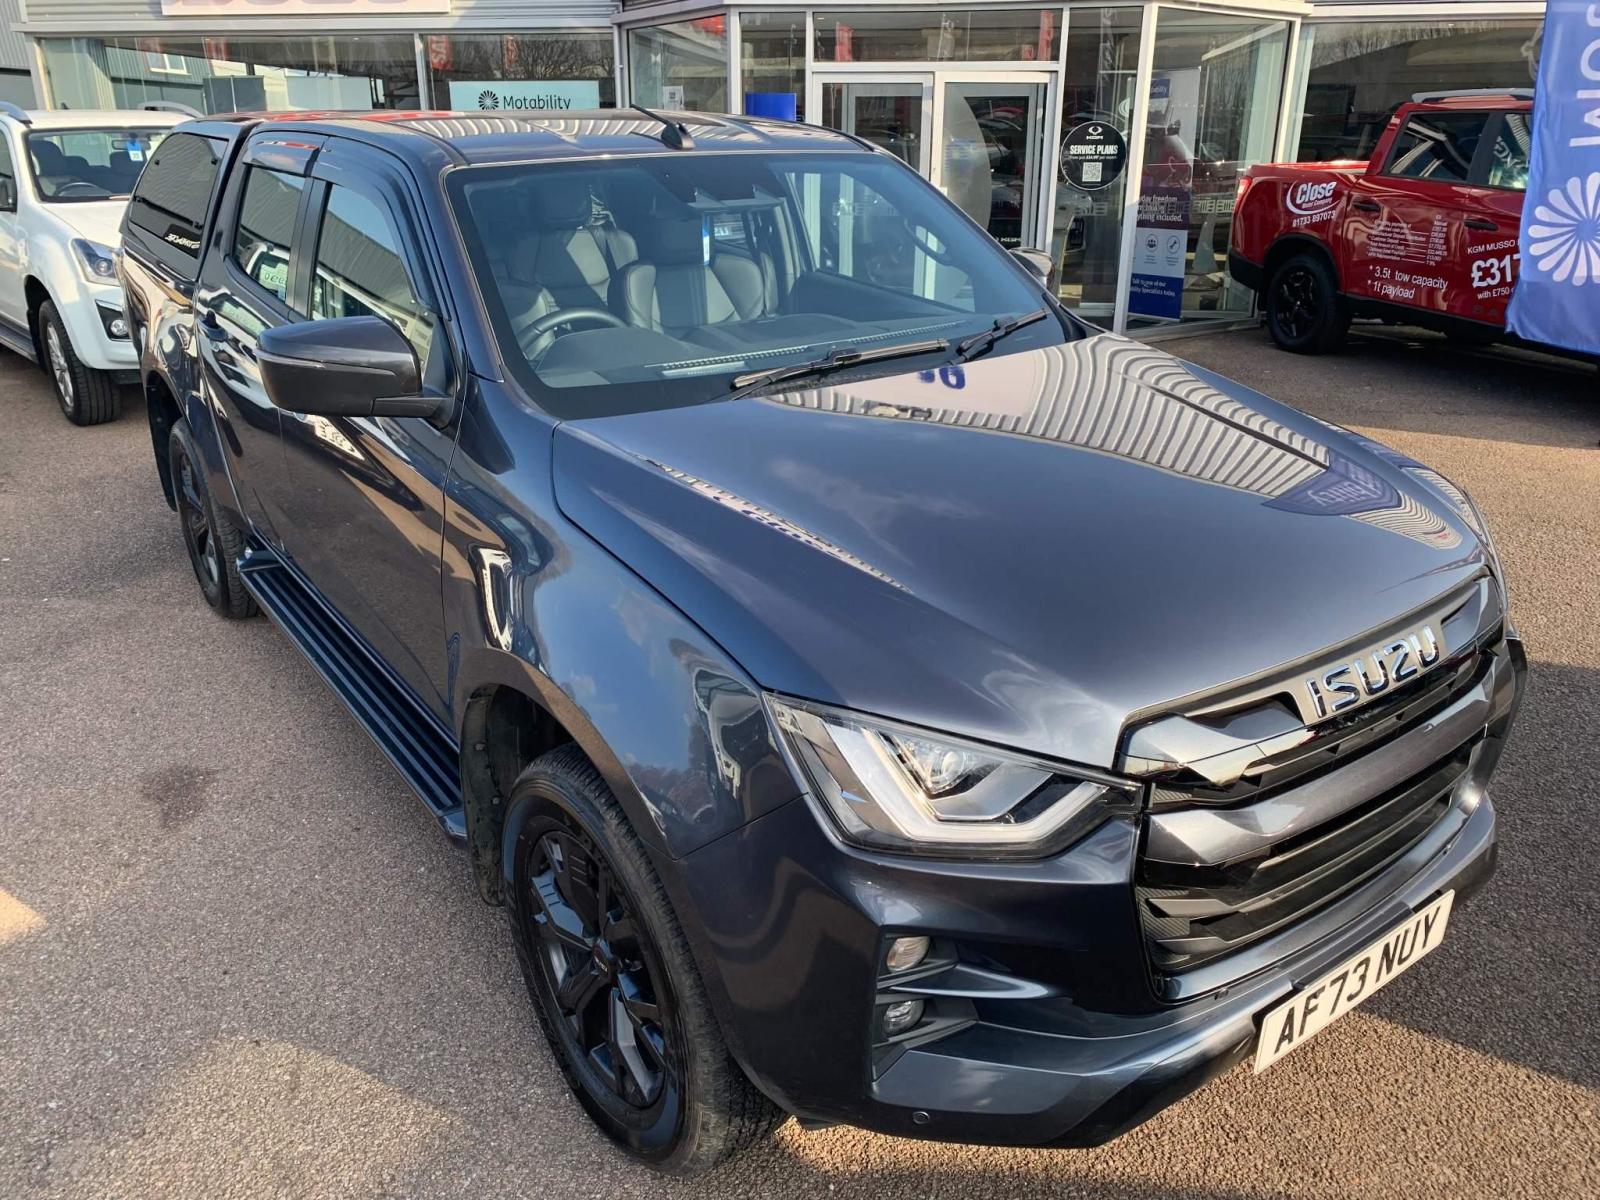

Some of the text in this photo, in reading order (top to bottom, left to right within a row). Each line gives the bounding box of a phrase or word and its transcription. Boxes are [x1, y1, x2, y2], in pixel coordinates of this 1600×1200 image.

[503, 95, 571, 110] Motability
[1069, 144, 1118, 155] SERVICE PLANS
[1295, 181, 1337, 204] Close
[1467, 239, 1516, 255] KGM MUSSO
[1394, 269, 1411, 283] tow
[1411, 275, 1449, 293] capacity
[1381, 284, 1416, 299] payload
[1477, 290, 1492, 299] with
[1305, 624, 1440, 719] ISUZU
[1274, 905, 1441, 1055] AF73 NUY
